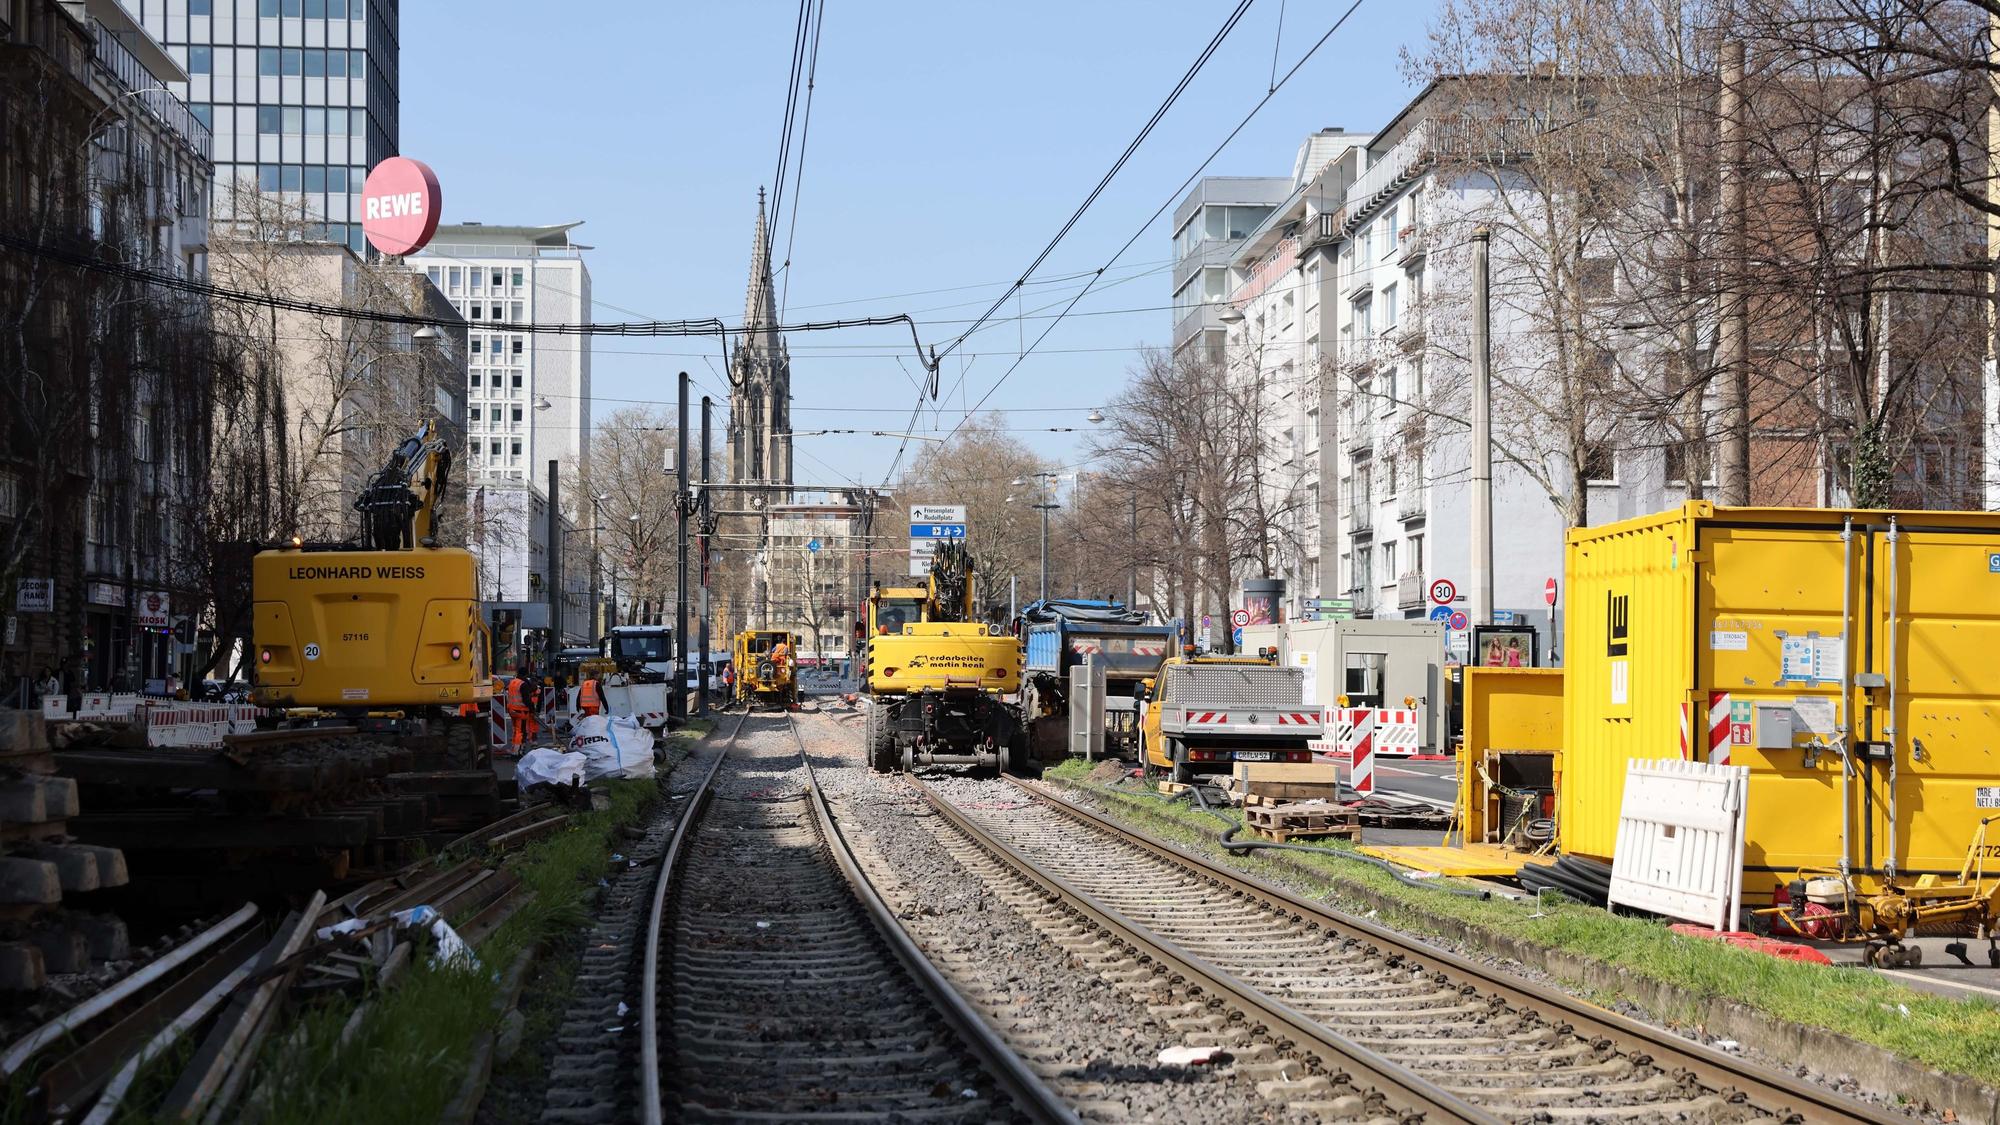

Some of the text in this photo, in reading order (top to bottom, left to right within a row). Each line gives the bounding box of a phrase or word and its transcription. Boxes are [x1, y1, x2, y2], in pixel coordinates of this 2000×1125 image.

[366, 192, 423, 220] REWE
[289, 567, 425, 579] LEONHARD WEISS
[1435, 586, 1451, 598] 30
[879, 600, 888, 608] 20
[139, 616, 166, 624] KIOSK
[1237, 614, 1247, 623] 30
[343, 633, 369, 641] 57116
[305, 646, 319, 656] 20
[1977, 787, 1991, 797] TARE
